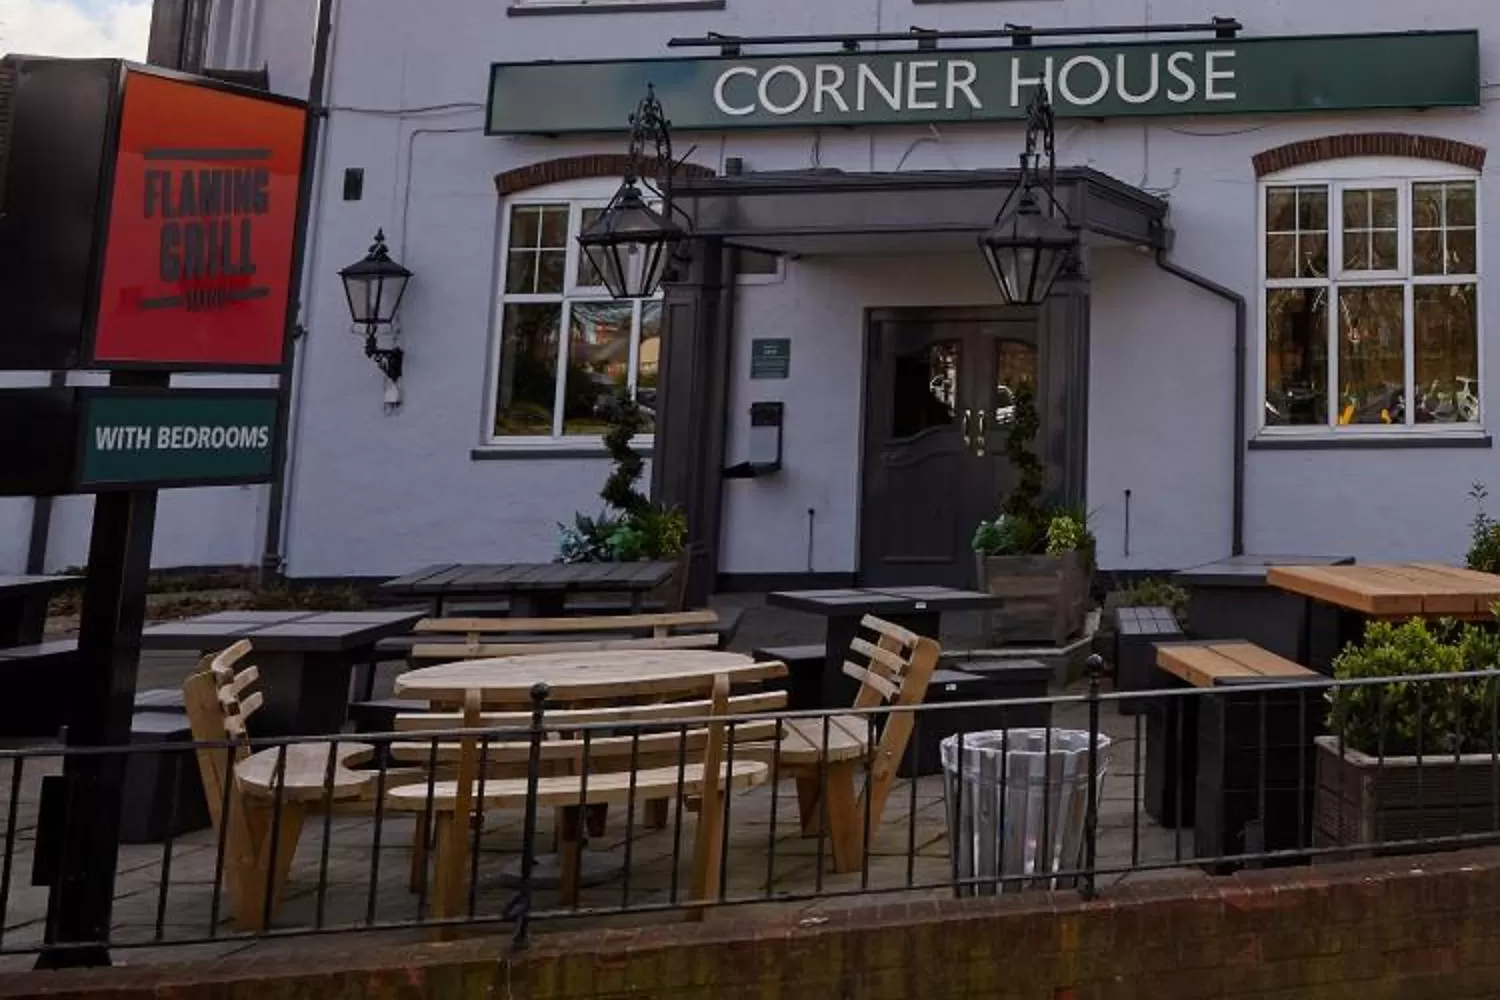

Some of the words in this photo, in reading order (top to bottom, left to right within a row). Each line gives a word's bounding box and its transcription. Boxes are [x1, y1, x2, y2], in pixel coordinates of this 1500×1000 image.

[714, 59, 982, 115] CORNER
[1010, 49, 1237, 108] HOUSE
[143, 168, 270, 219] FLAMING
[160, 218, 256, 283] GRILL
[96, 426, 151, 451] WITH
[156, 425, 269, 449] BEDROOMS
